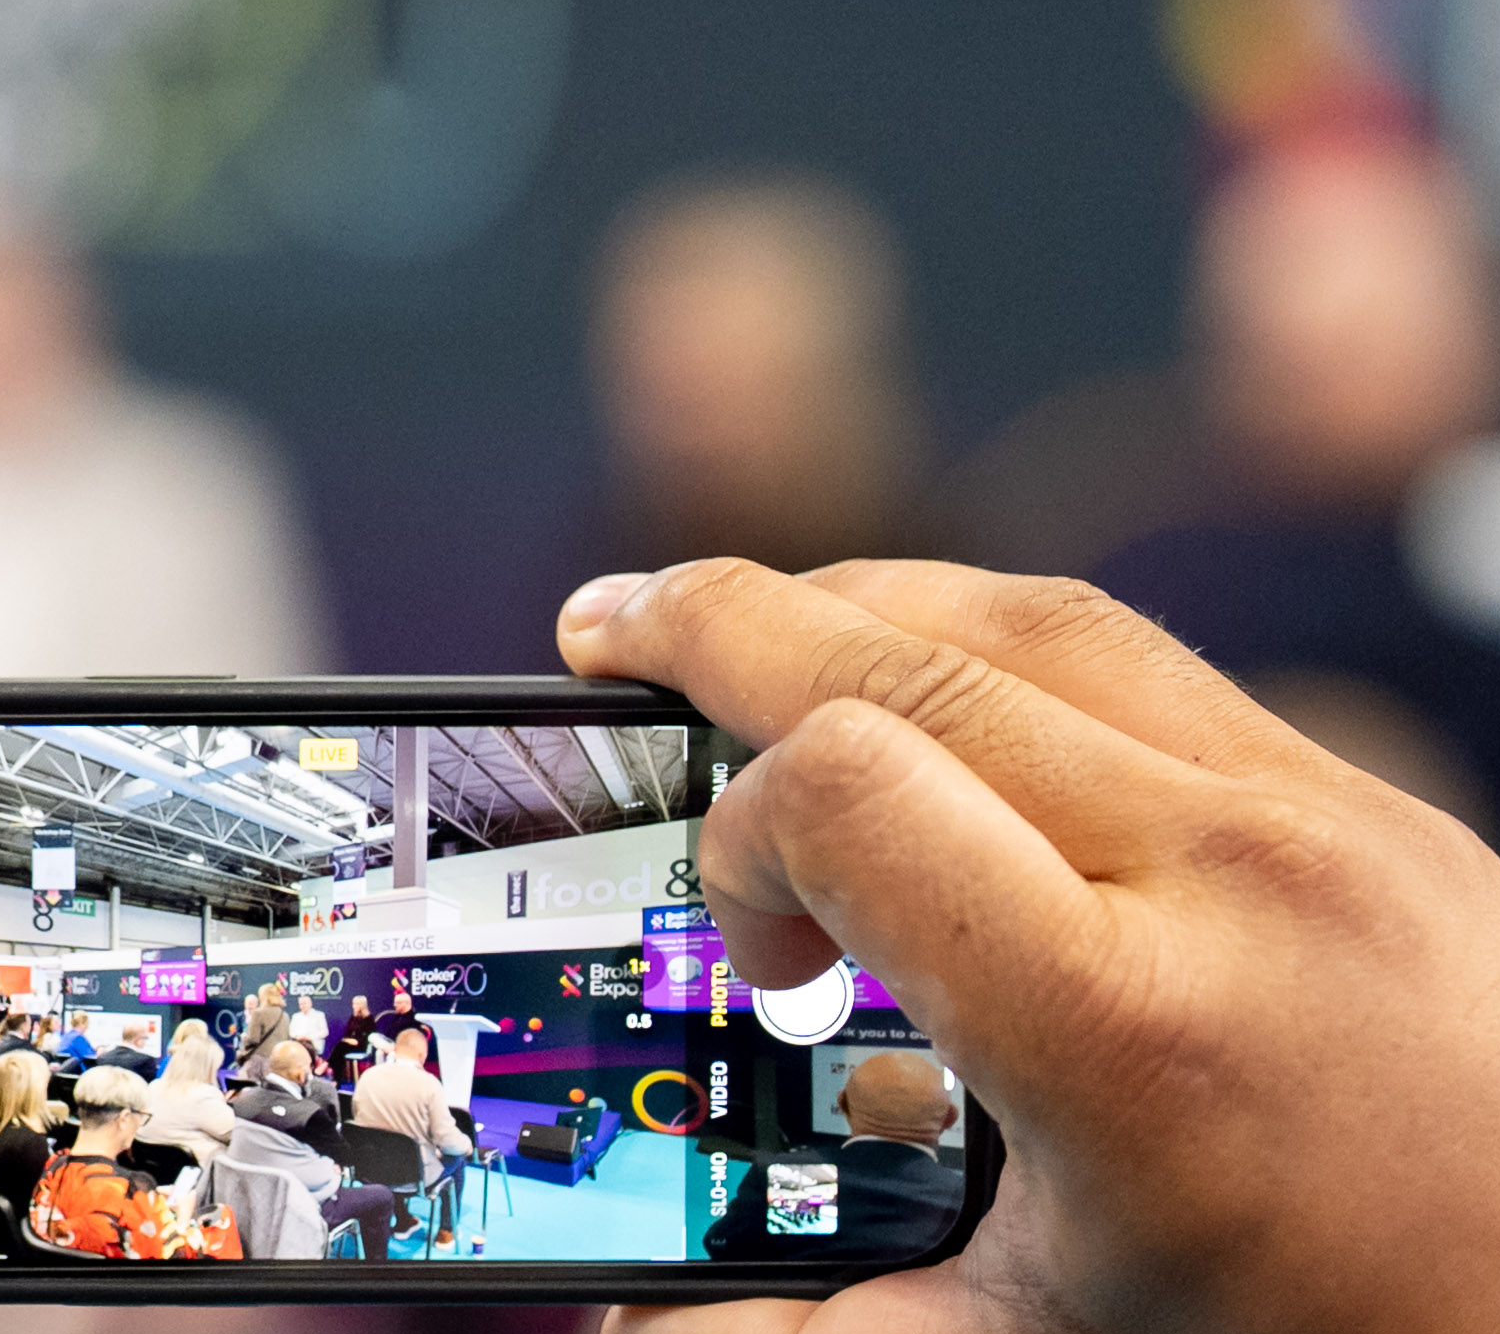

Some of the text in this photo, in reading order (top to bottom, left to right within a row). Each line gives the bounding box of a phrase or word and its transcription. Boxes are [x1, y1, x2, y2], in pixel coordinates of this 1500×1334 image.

[309, 747, 348, 762] LIVE
[533, 858, 703, 910] food &
[63, 898, 93, 914] XIT
[309, 935, 435, 955] HEADLINE STAGE
[411, 968, 457, 982] Broker
[590, 963, 643, 980] Brok
[629, 958, 651, 975] 1x
[313, 967, 344, 995] 20
[446, 962, 487, 996] 20
[411, 982, 446, 998] Expo
[590, 979, 640, 1000] Expo
[711, 962, 728, 1027] PHOTO
[859, 1029, 887, 1040] you
[889, 1029, 906, 1039] to
[710, 1061, 728, 1119] VIDEO
[710, 1152, 728, 1217] SLO-MO
